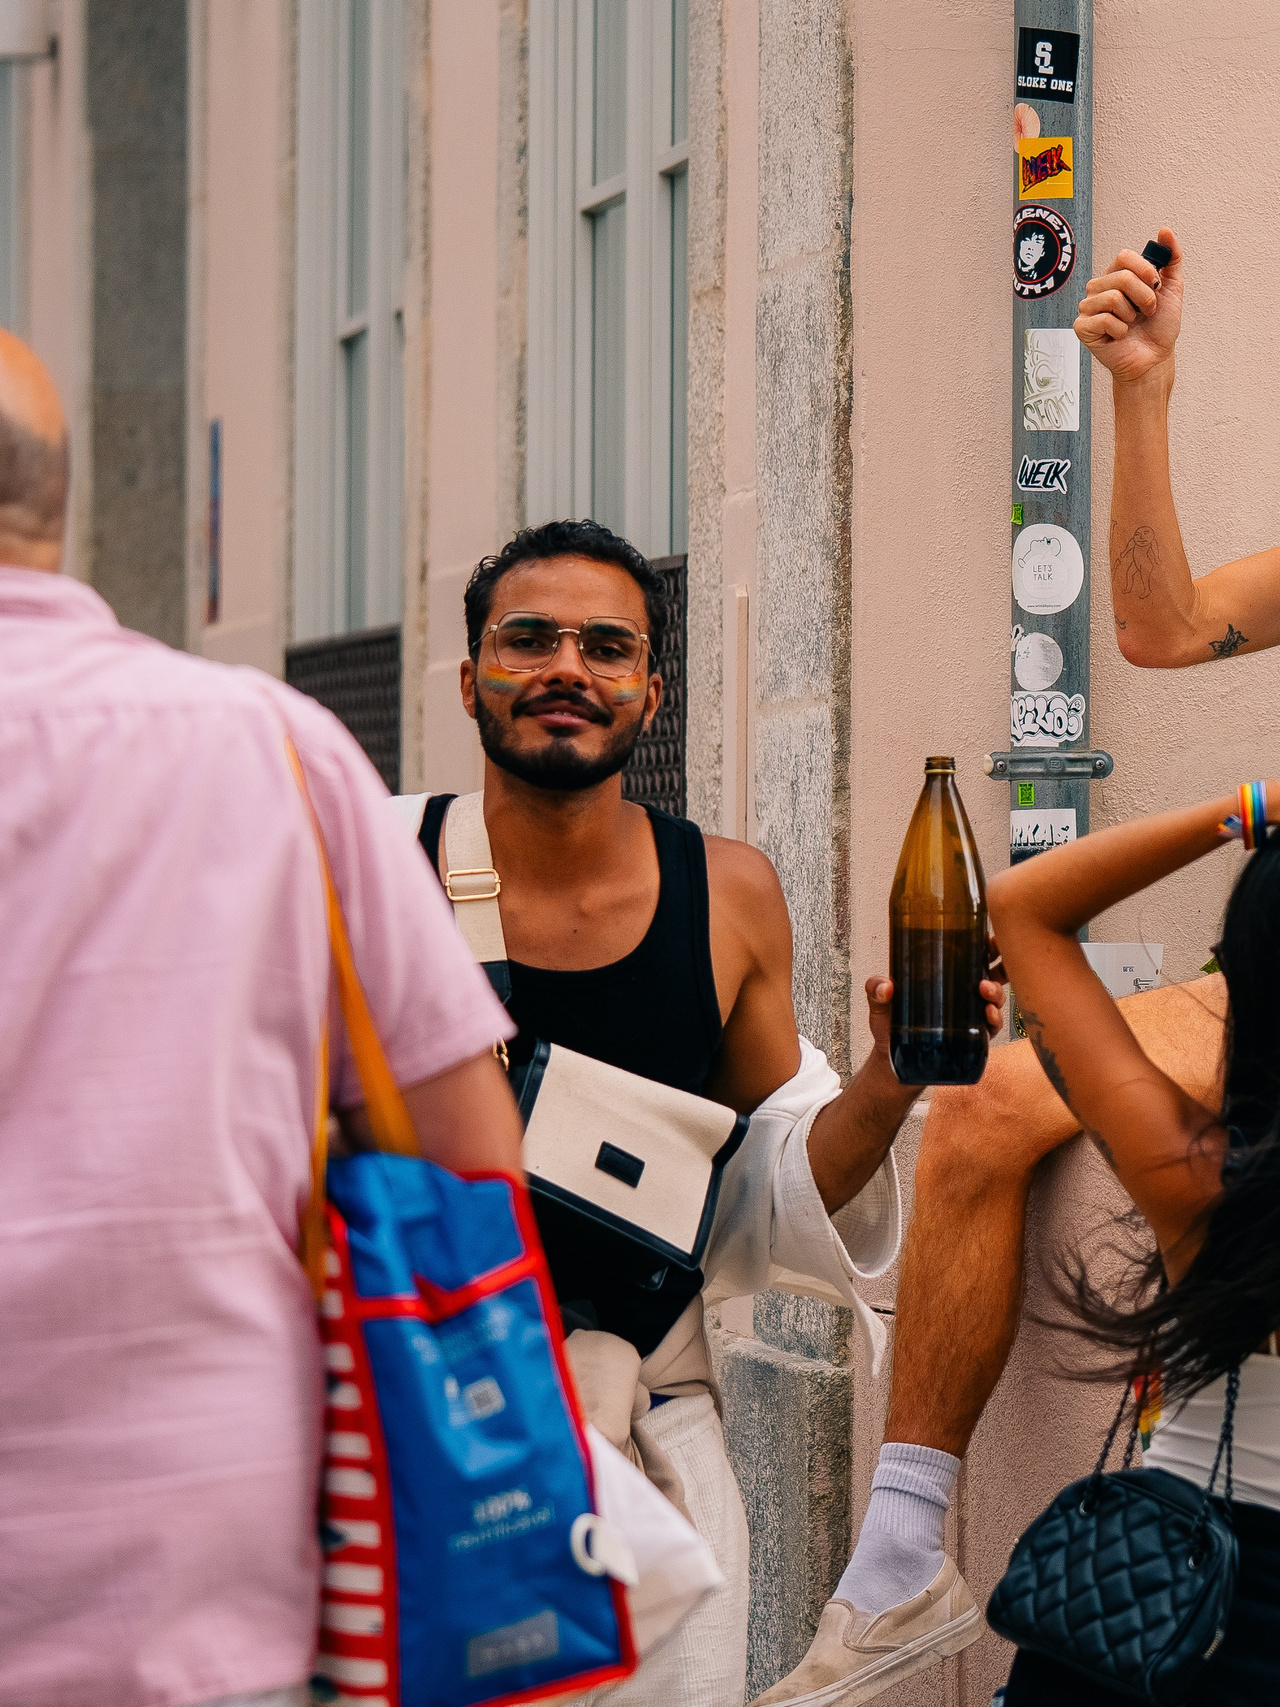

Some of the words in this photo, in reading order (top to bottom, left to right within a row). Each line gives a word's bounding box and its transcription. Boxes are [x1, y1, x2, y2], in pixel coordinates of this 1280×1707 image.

[1017, 75, 1048, 89] SLOKE
[1050, 78, 1074, 93] ONE
[1013, 207, 1073, 272] RENETIC
[1032, 564, 1053, 573] LET'S
[1033, 573, 1053, 581] TALK
